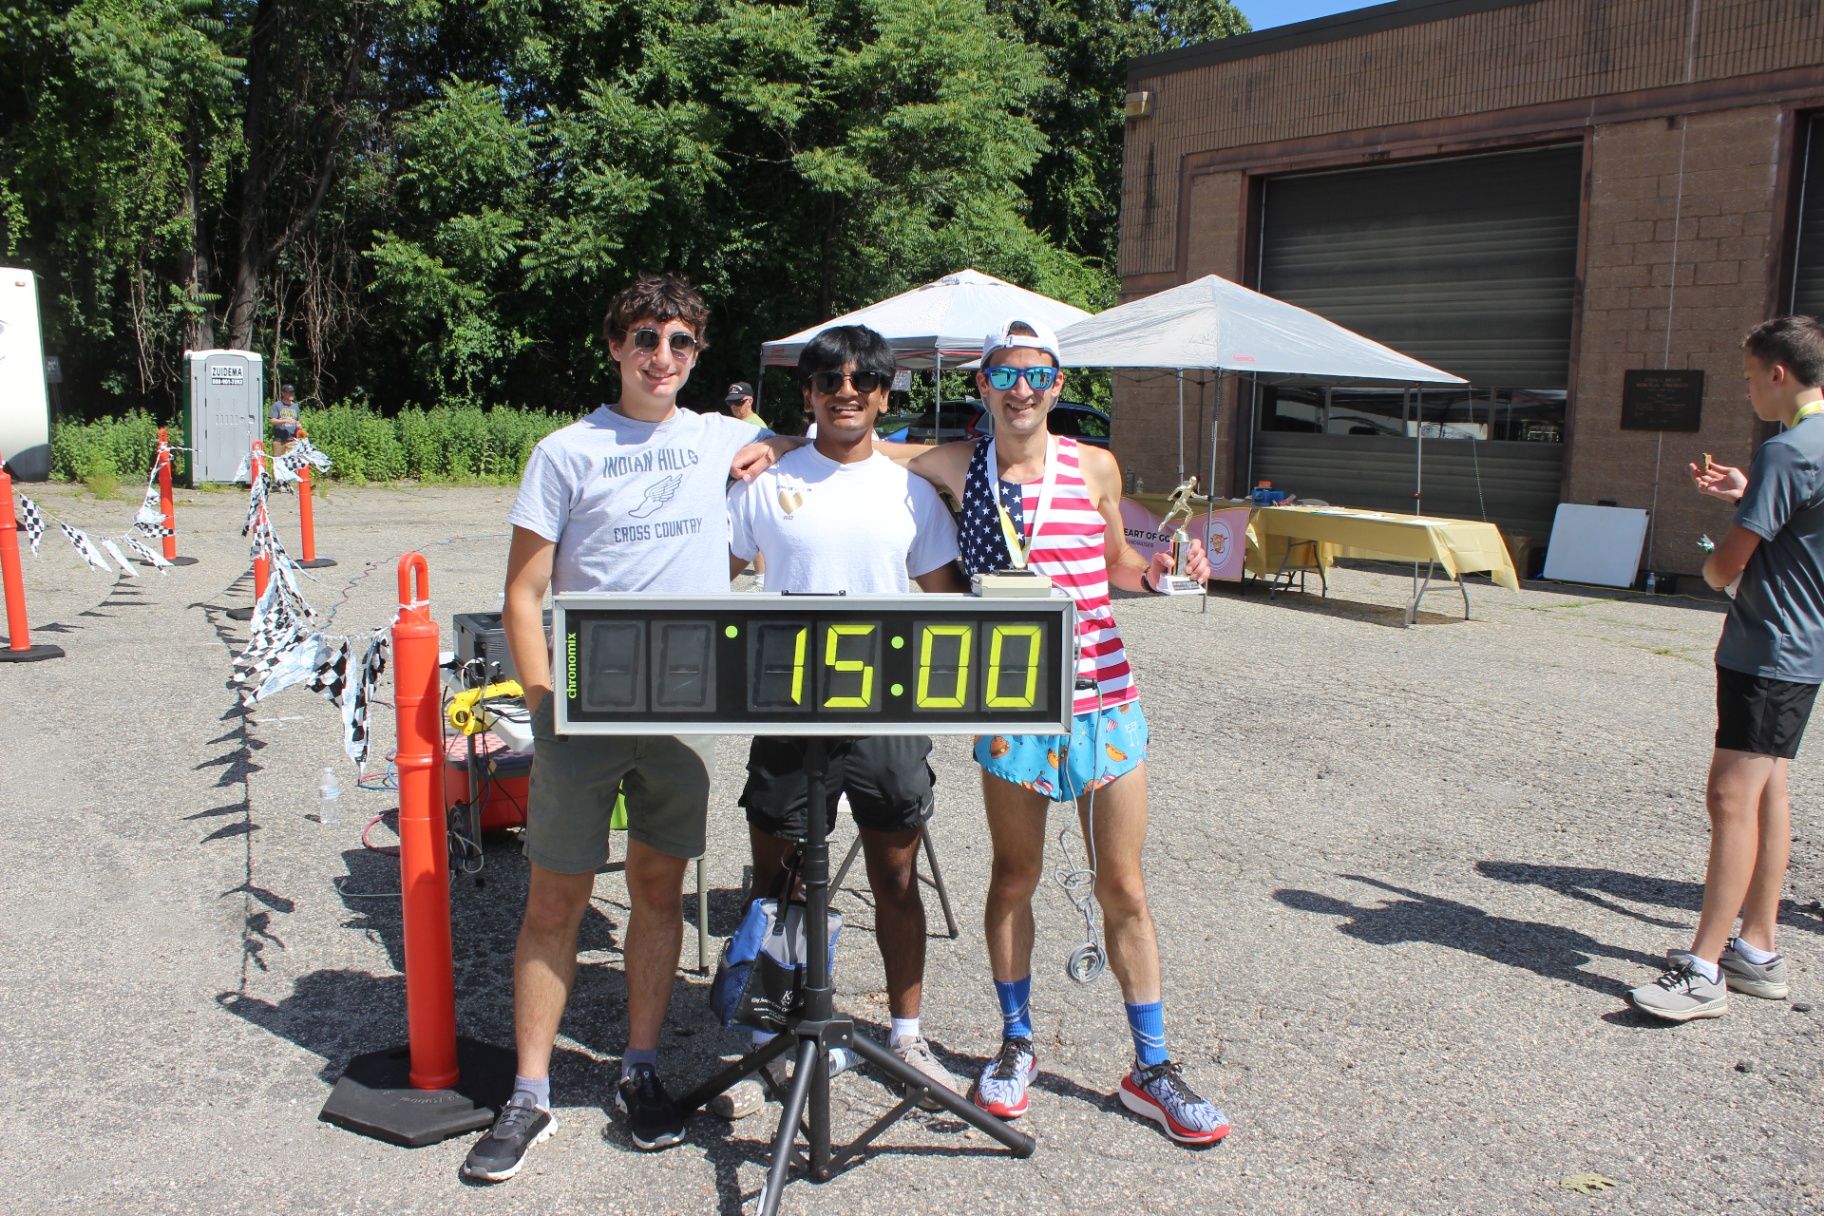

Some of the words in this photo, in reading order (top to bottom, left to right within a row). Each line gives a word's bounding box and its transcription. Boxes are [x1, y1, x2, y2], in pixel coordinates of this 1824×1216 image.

[212, 367, 243, 377] ZUIDEMA
[602, 450, 653, 478] INDIAN
[657, 448, 699, 471] HILLS
[613, 524, 651, 543] CROSS
[654, 517, 703, 539] COUNTRY
[1124, 527, 1144, 539] EART
[1146, 531, 1157, 541] OF
[566, 632, 577, 699] chronomix
